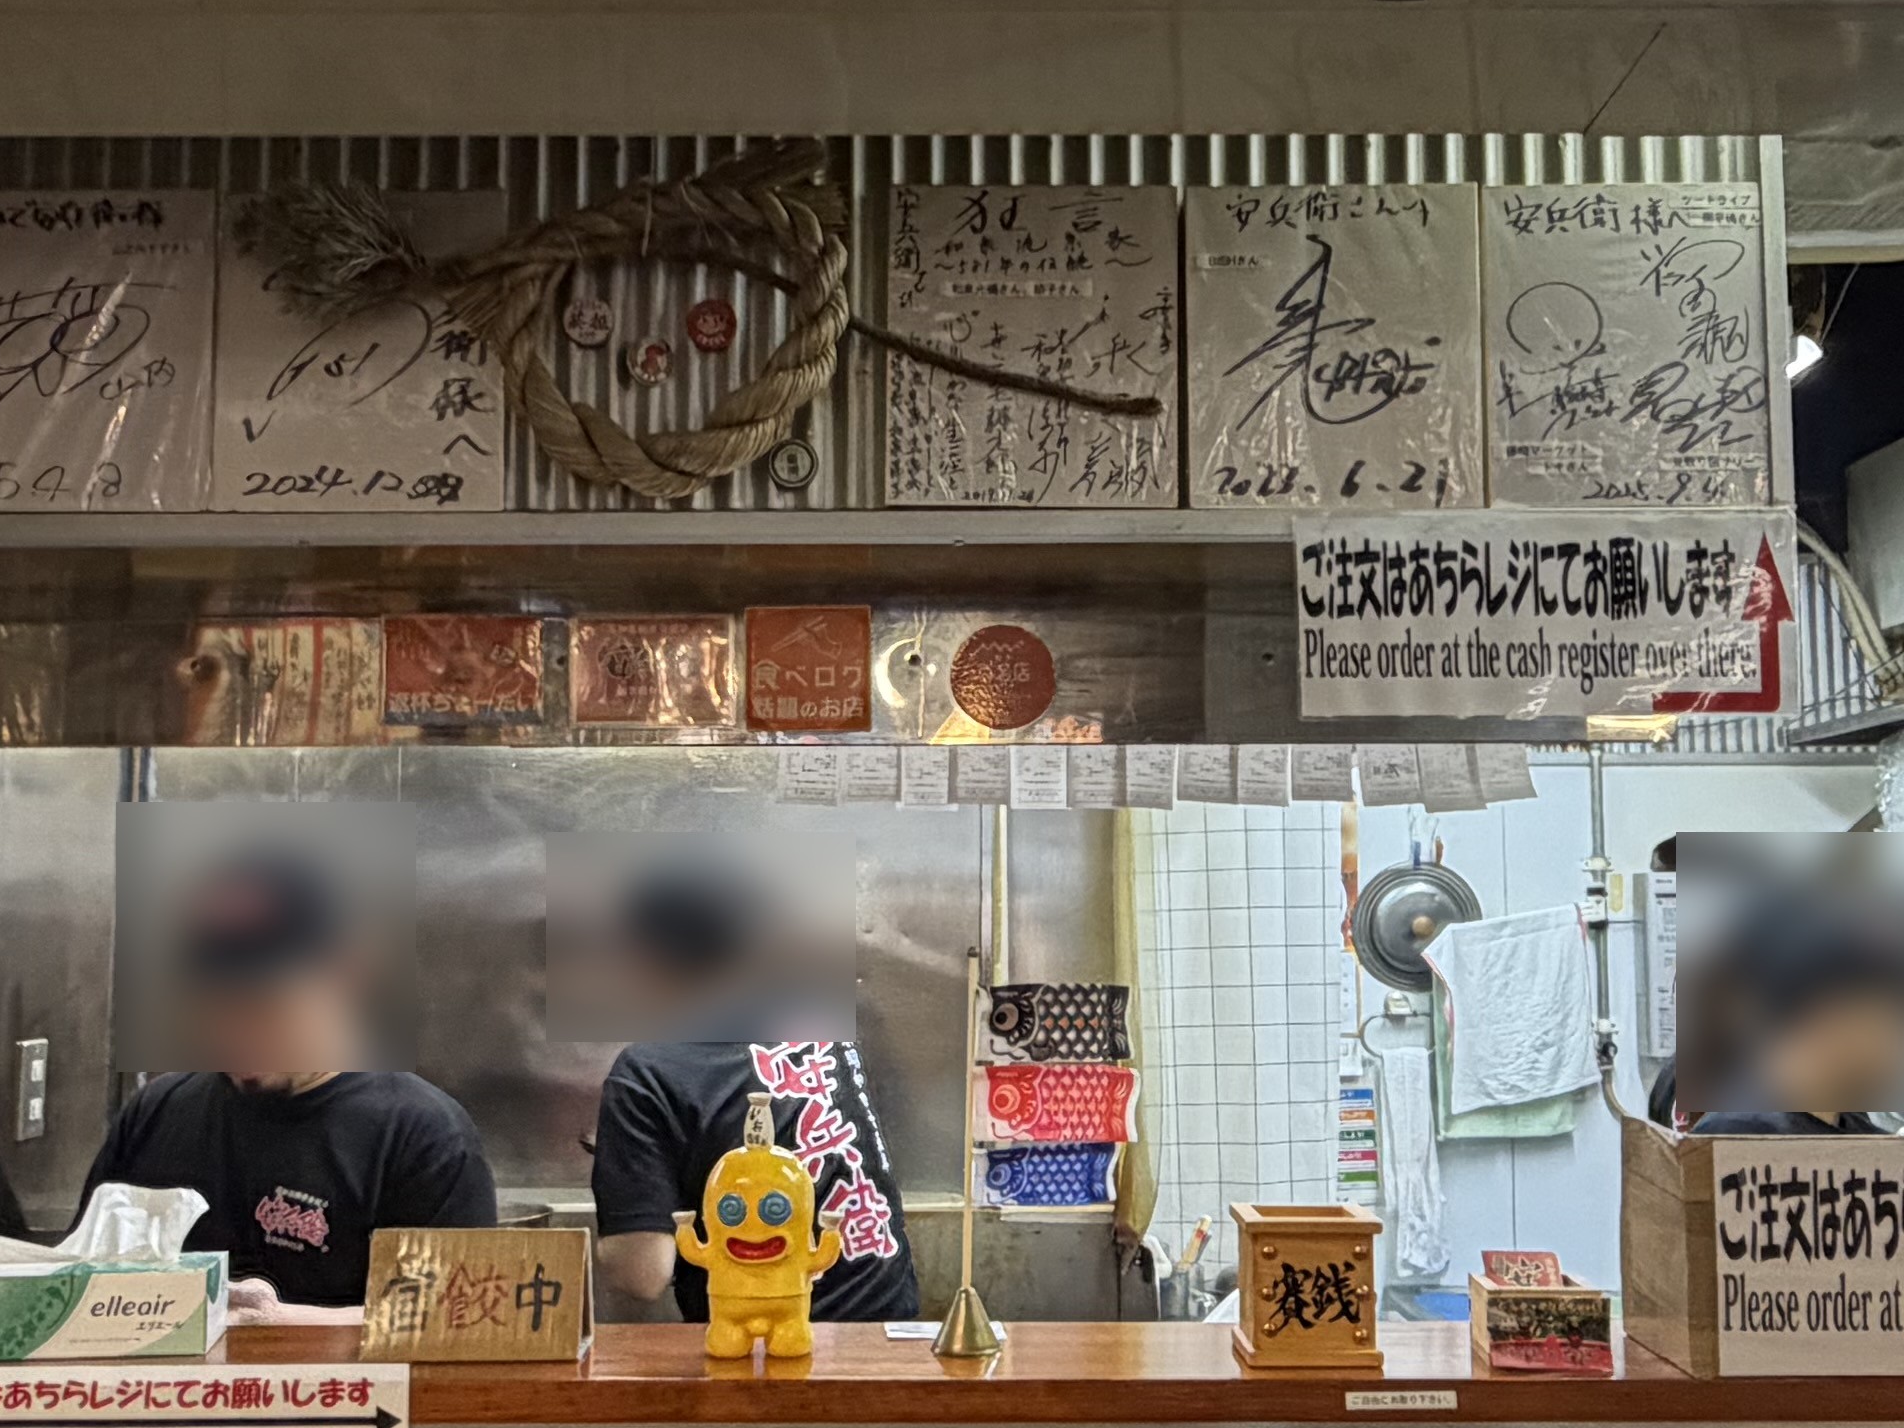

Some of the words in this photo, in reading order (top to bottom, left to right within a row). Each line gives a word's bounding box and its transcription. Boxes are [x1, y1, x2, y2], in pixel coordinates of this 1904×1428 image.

[1300, 536, 1737, 621] ご注文はあちらレジにてお願いします
[752, 657, 864, 692] 食べログ
[1304, 627, 1372, 679] Please
[1377, 627, 1436, 679] order
[1440, 636, 1464, 679] at
[1466, 627, 1502, 679] the
[1505, 627, 1554, 679] cash
[1558, 630, 1640, 695] register
[89, 1293, 178, 1319] elleair
[1721, 1272, 1801, 1334] Please
[1807, 1272, 1874, 1334] order
